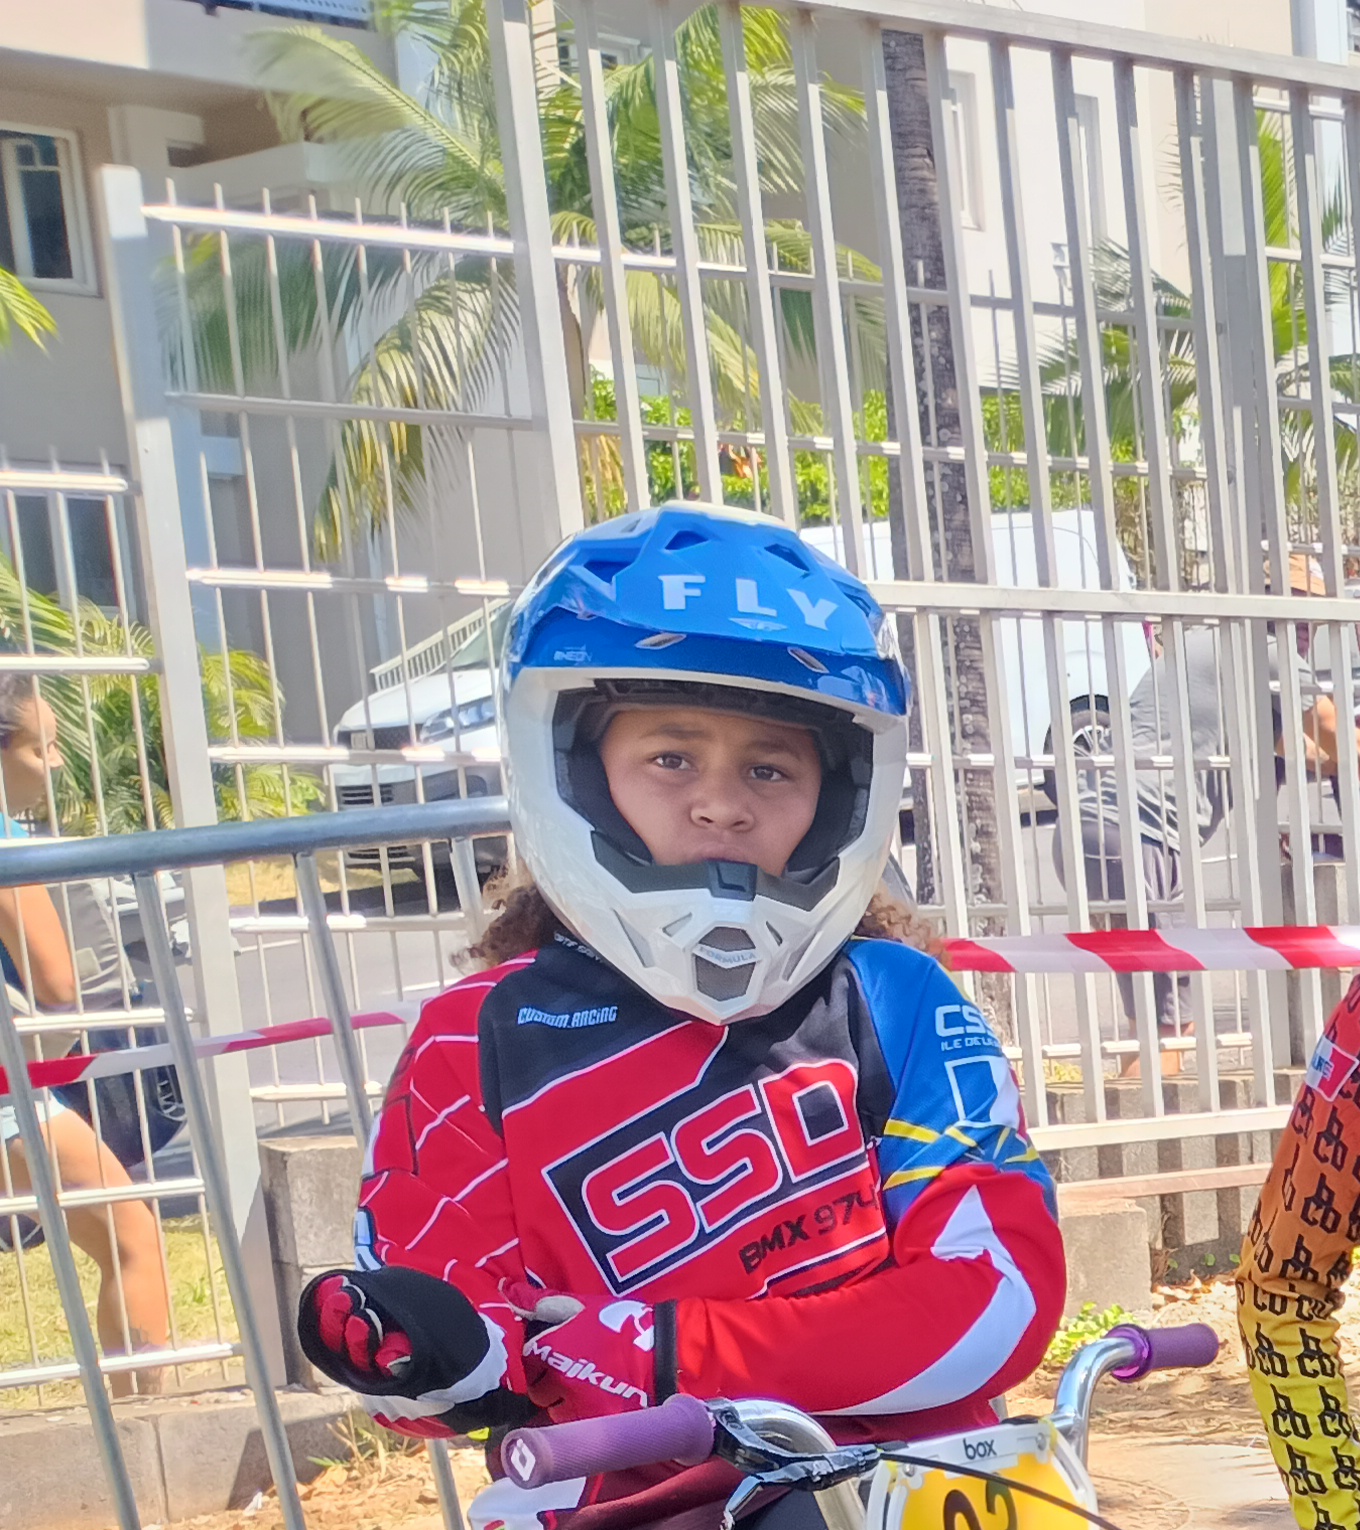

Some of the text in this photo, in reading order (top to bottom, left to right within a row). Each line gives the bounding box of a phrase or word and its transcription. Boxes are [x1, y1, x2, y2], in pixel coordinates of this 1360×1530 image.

[658, 574, 838, 630] FLY
[582, 1059, 866, 1283] SSD
[738, 1213, 810, 1275] BMX
[963, 1438, 997, 1460] box
